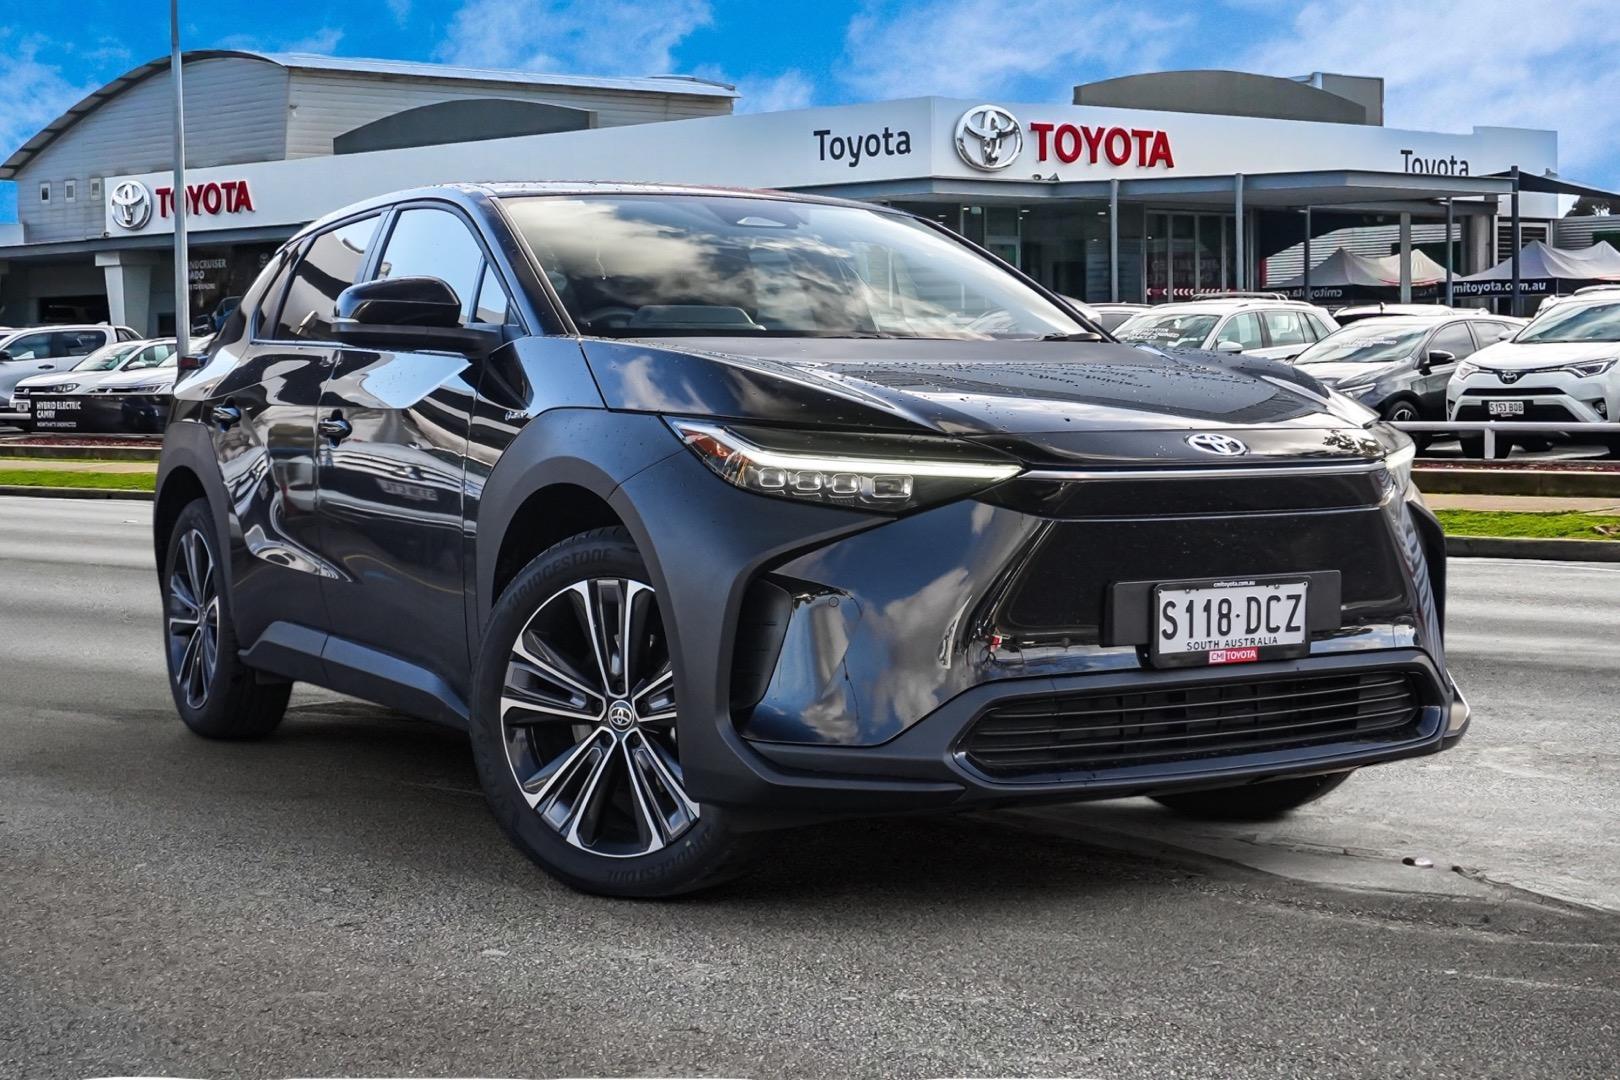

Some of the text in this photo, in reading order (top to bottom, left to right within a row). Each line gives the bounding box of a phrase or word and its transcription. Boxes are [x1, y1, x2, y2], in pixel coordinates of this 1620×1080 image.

[813, 127, 911, 168] Toyota
[1030, 122, 1174, 168] TOYOTA
[37, 401, 57, 410] HYBRID
[57, 401, 81, 410] ELECTRIC
[37, 410, 56, 419] CAMRY
[1186, 636, 1279, 652] SOUTH AUSTRALIA
[1225, 650, 1257, 661] TOYOTA
